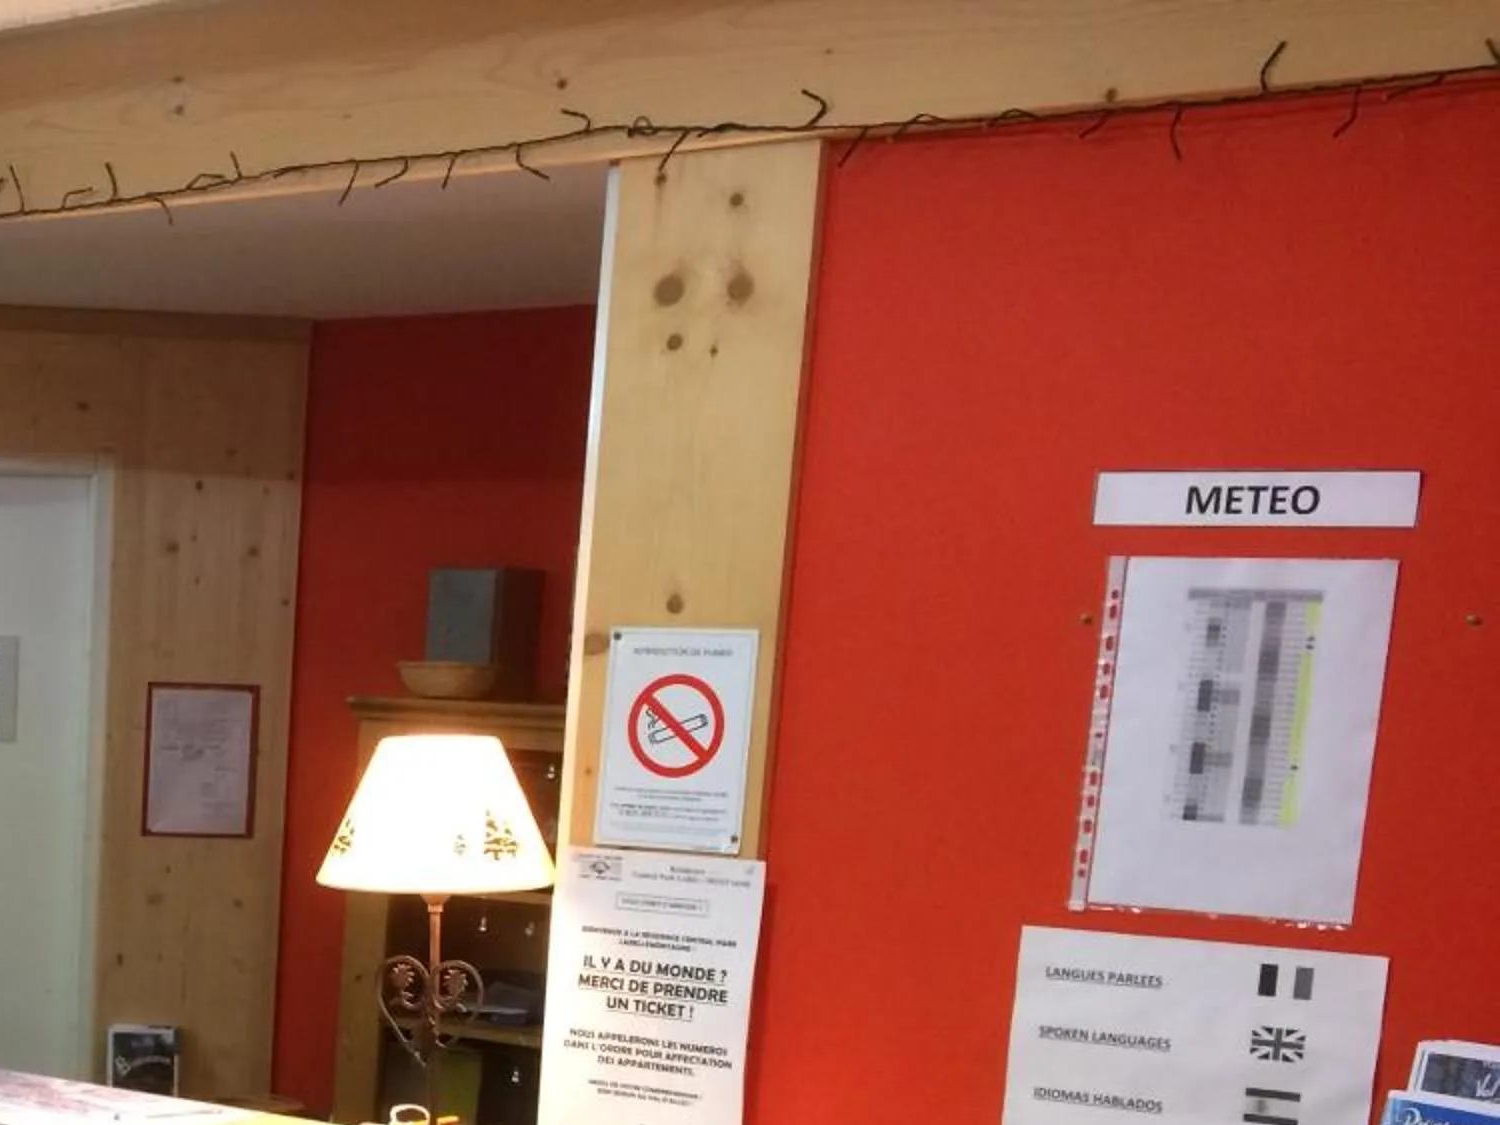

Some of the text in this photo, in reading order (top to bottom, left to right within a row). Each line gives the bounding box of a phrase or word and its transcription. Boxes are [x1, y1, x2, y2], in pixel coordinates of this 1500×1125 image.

[1185, 485, 1321, 515] METEO
[583, 954, 728, 983] IL Y A DU MONDE ?
[1045, 964, 1163, 989] LANGUES PARLEES
[578, 973, 729, 1003] MERCI DE PRENDRE
[606, 996, 629, 1011] UN
[634, 999, 686, 1018] TICKET
[569, 1027, 595, 1039] NOUS
[1038, 1024, 1172, 1052] SPOKEN LANGUAGES
[635, 1049, 663, 1061] POUR
[1033, 1086, 1163, 1115] IDIOMAS HABLADOS
